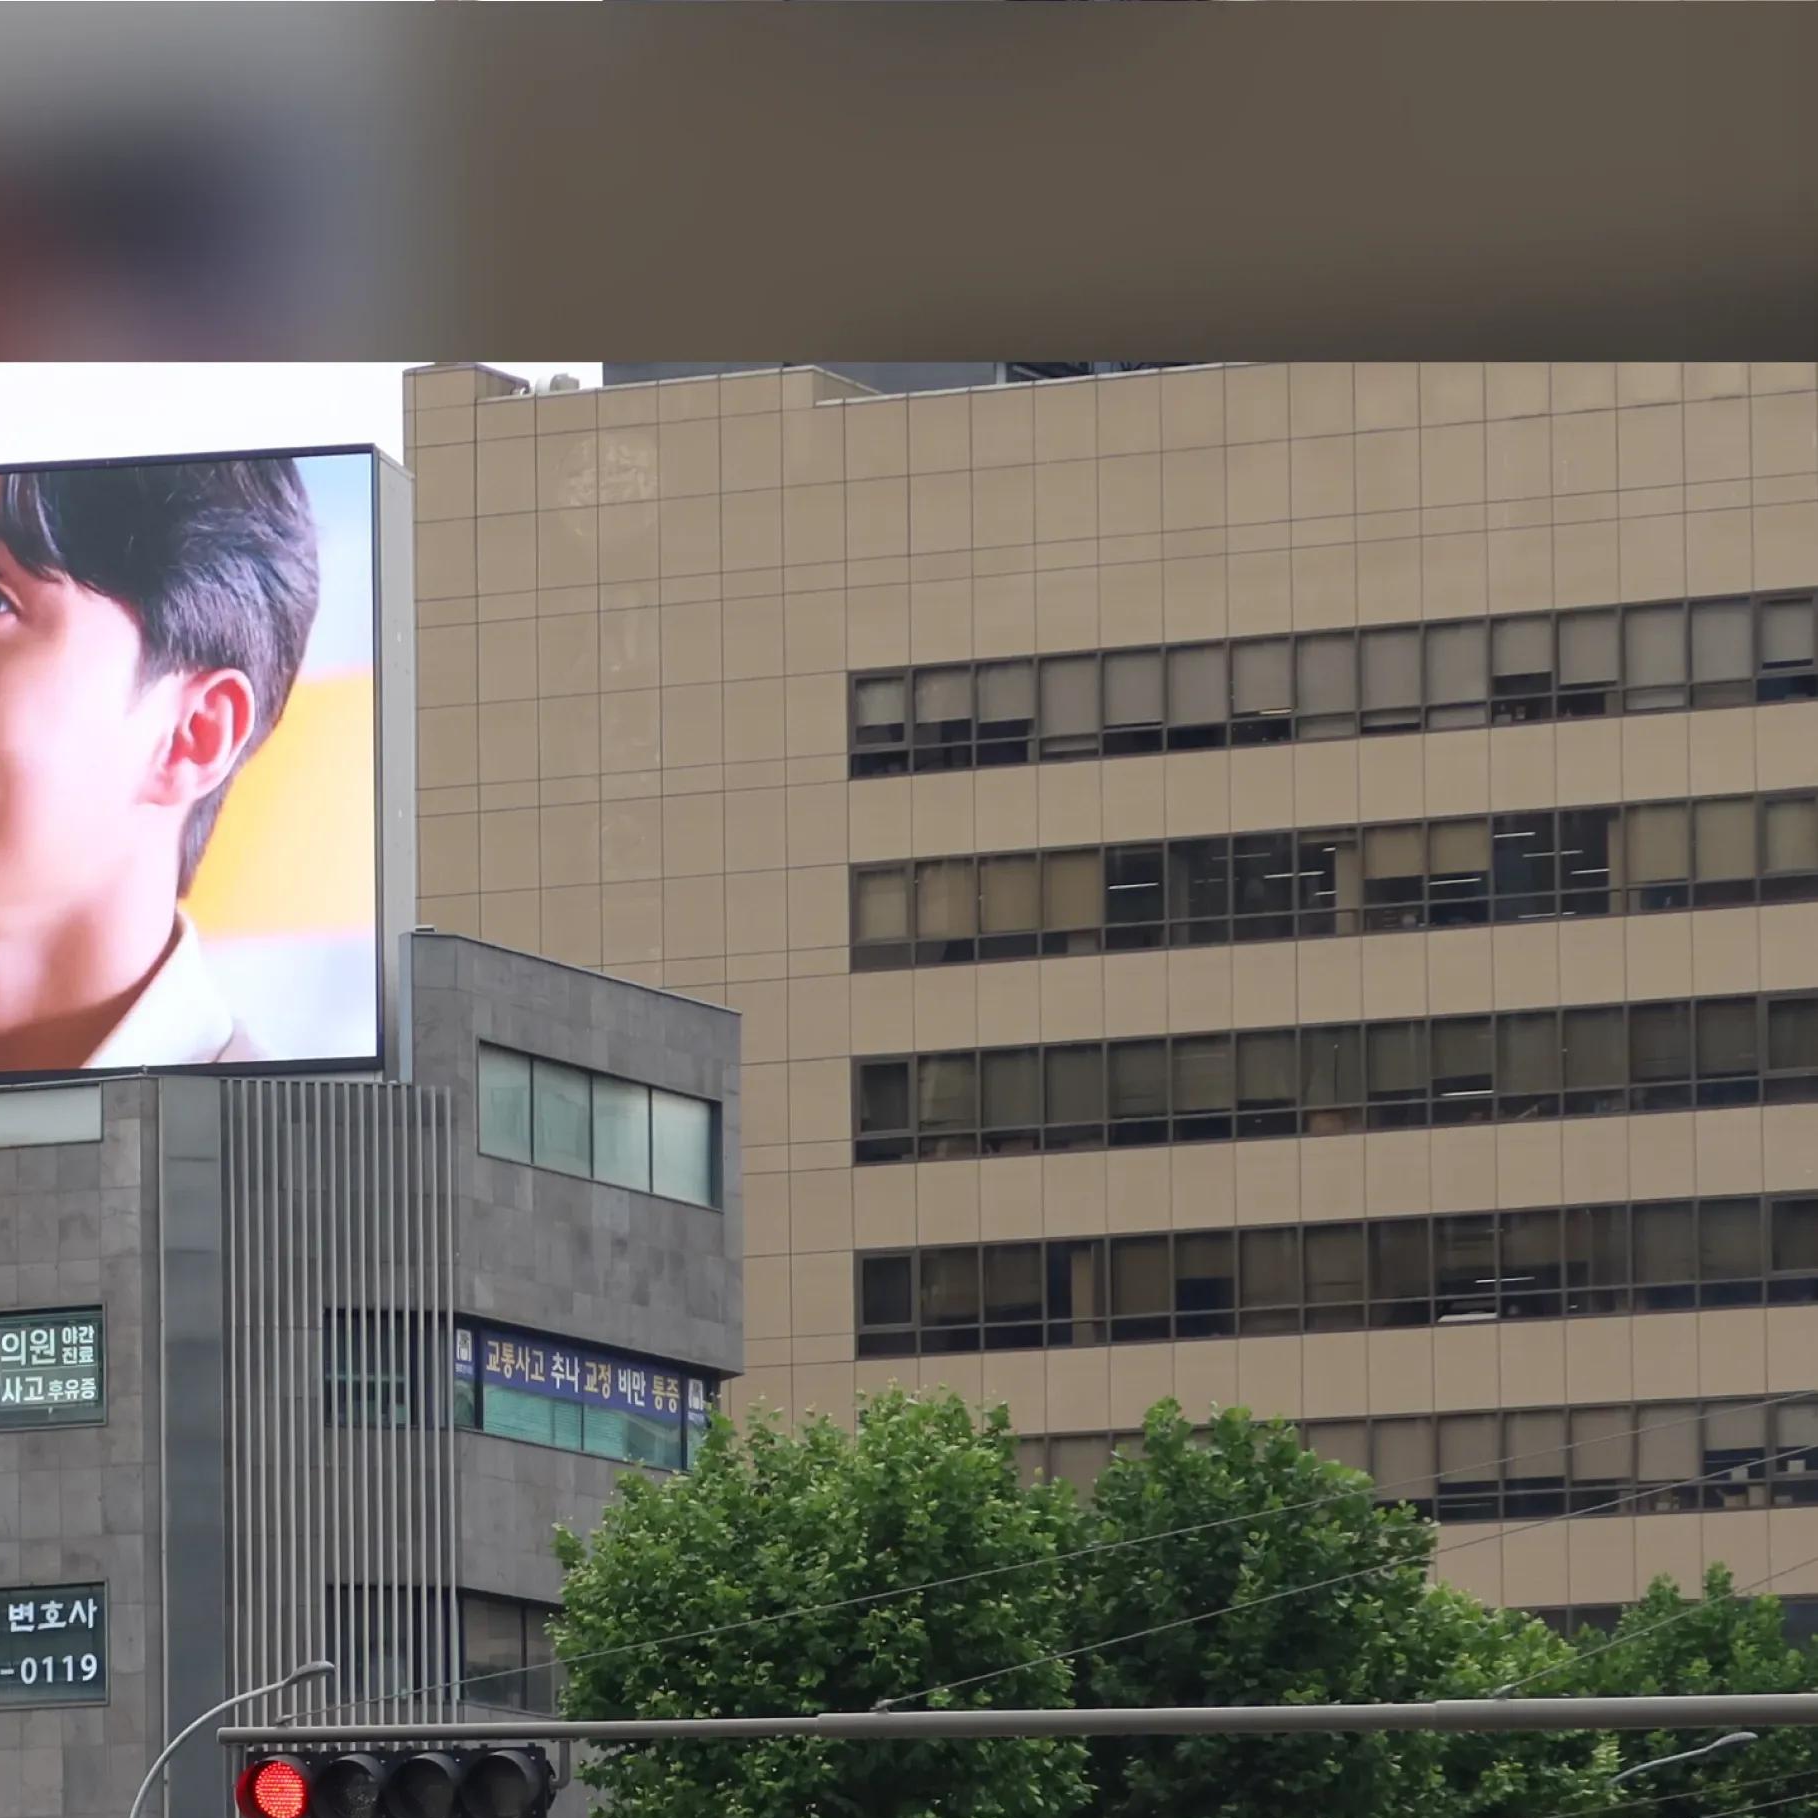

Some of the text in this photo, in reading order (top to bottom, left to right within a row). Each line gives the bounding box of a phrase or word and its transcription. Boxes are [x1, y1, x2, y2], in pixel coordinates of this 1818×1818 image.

[61, 1325, 95, 1345] 야간
[61, 1346, 95, 1365] 진료
[47, 1377, 97, 1401] 후유증
[485, 1340, 680, 1414] 교통사고 추나 교정 비만 통증
[7, 1598, 98, 1634] 변호사
